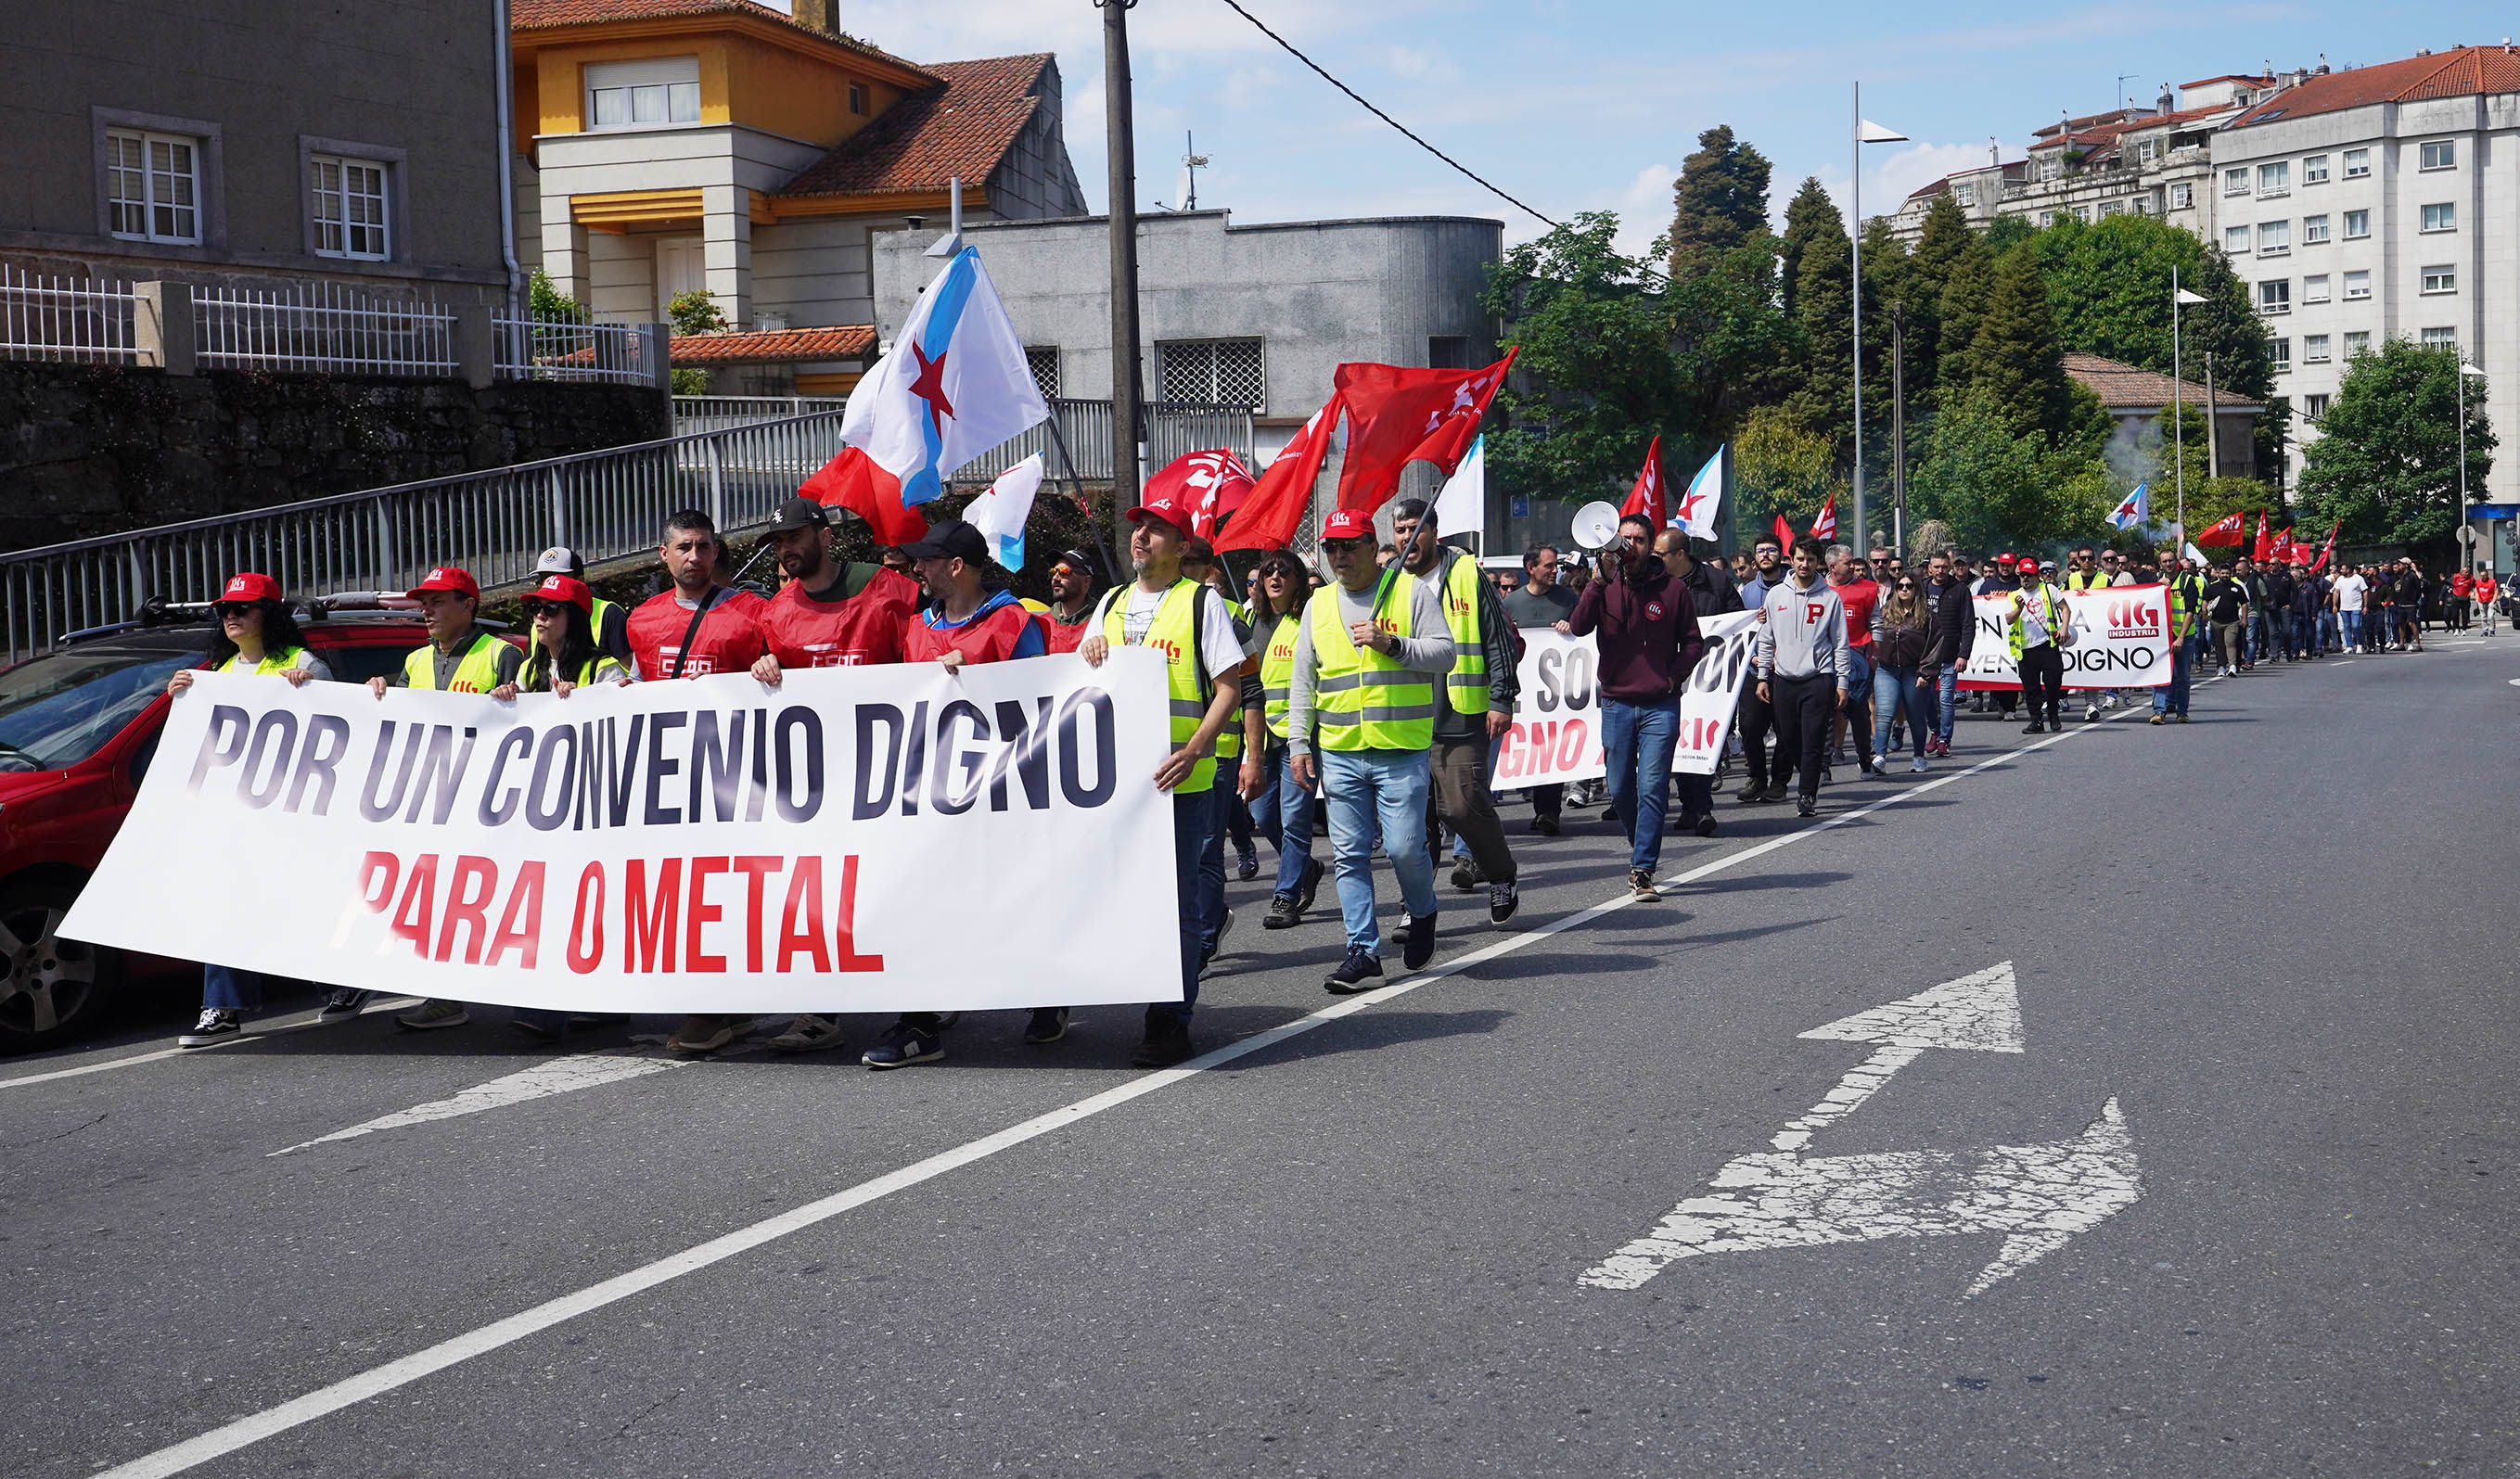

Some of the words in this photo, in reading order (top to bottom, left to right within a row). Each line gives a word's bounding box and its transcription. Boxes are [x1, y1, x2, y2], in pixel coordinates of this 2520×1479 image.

[1452, 598, 1469, 611] IG
[1807, 604, 1824, 624] P
[2107, 599, 2159, 628] CIG
[1374, 618, 1397, 632] IG
[2109, 629, 2157, 638] INDUSTRIA
[1274, 644, 1292, 657] CIG
[2062, 646, 2155, 671] DIGNO
[186, 705, 350, 816] POR
[360, 720, 477, 825] UN
[478, 706, 825, 831] CONVENIO
[852, 685, 1117, 820] DIGNO
[1499, 719, 1588, 778] GNO
[328, 850, 546, 970] PARA
[566, 861, 605, 975] O
[624, 855, 884, 974] METAL
